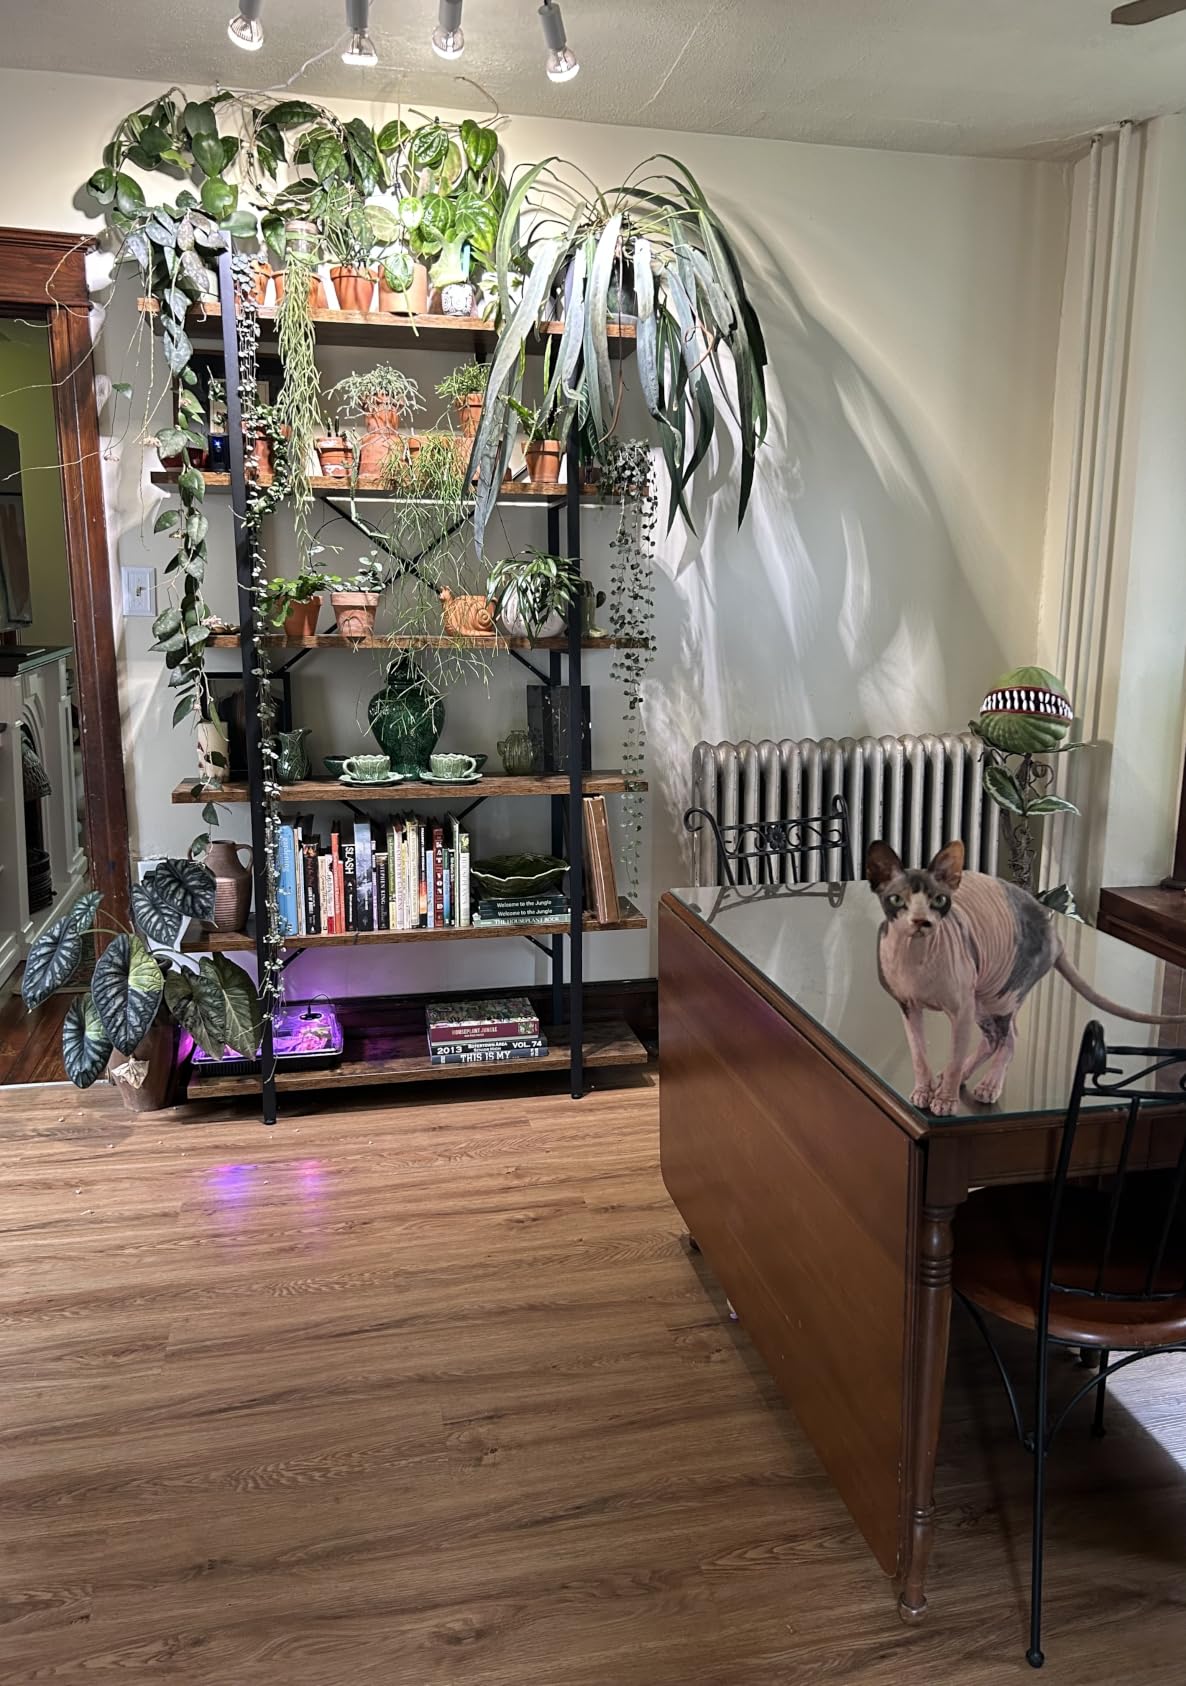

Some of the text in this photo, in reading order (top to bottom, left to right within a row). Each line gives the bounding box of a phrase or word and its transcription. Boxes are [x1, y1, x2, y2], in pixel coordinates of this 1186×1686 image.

[282, 838, 292, 873] gardening
[345, 847, 354, 875] SLASH
[437, 1046, 462, 1055] 2013
[460, 1050, 511, 1063] THIS IS MY
